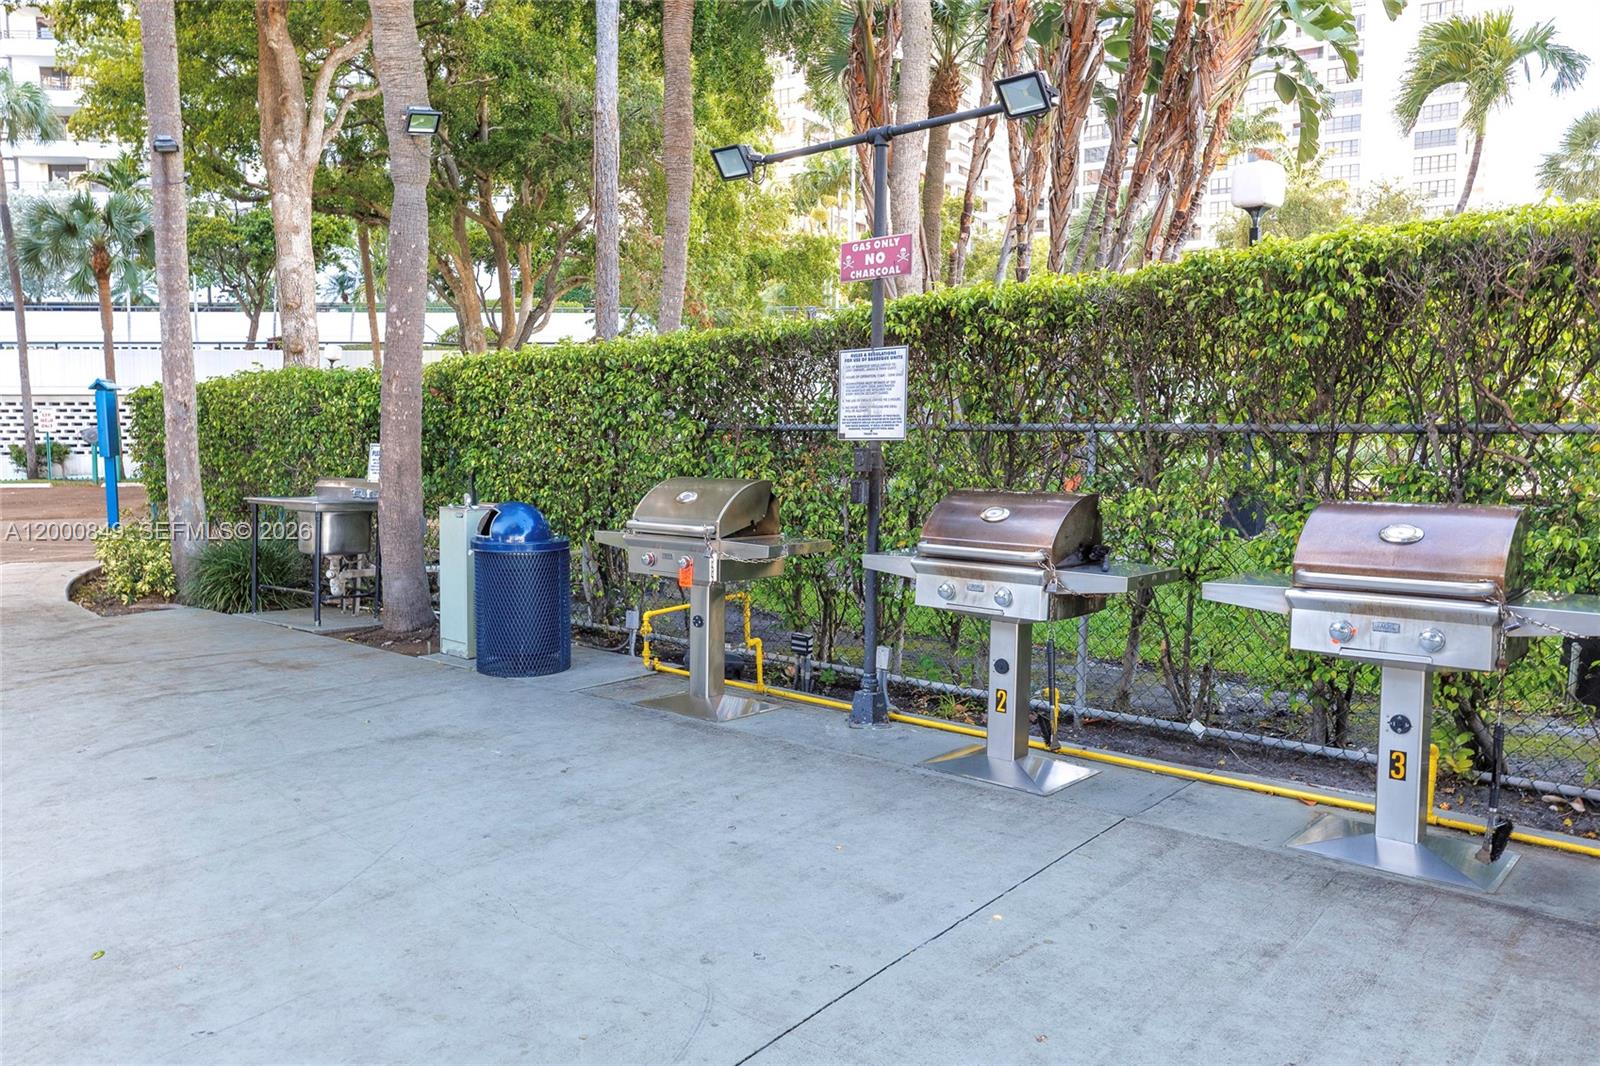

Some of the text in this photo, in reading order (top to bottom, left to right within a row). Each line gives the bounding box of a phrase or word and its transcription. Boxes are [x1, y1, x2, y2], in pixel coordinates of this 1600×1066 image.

[852, 237, 900, 252] GAS ONLY
[864, 251, 886, 266] NO
[850, 265, 901, 279] CHARCOAL
[997, 690, 1006, 712] 2
[1391, 751, 1405, 778] 3
